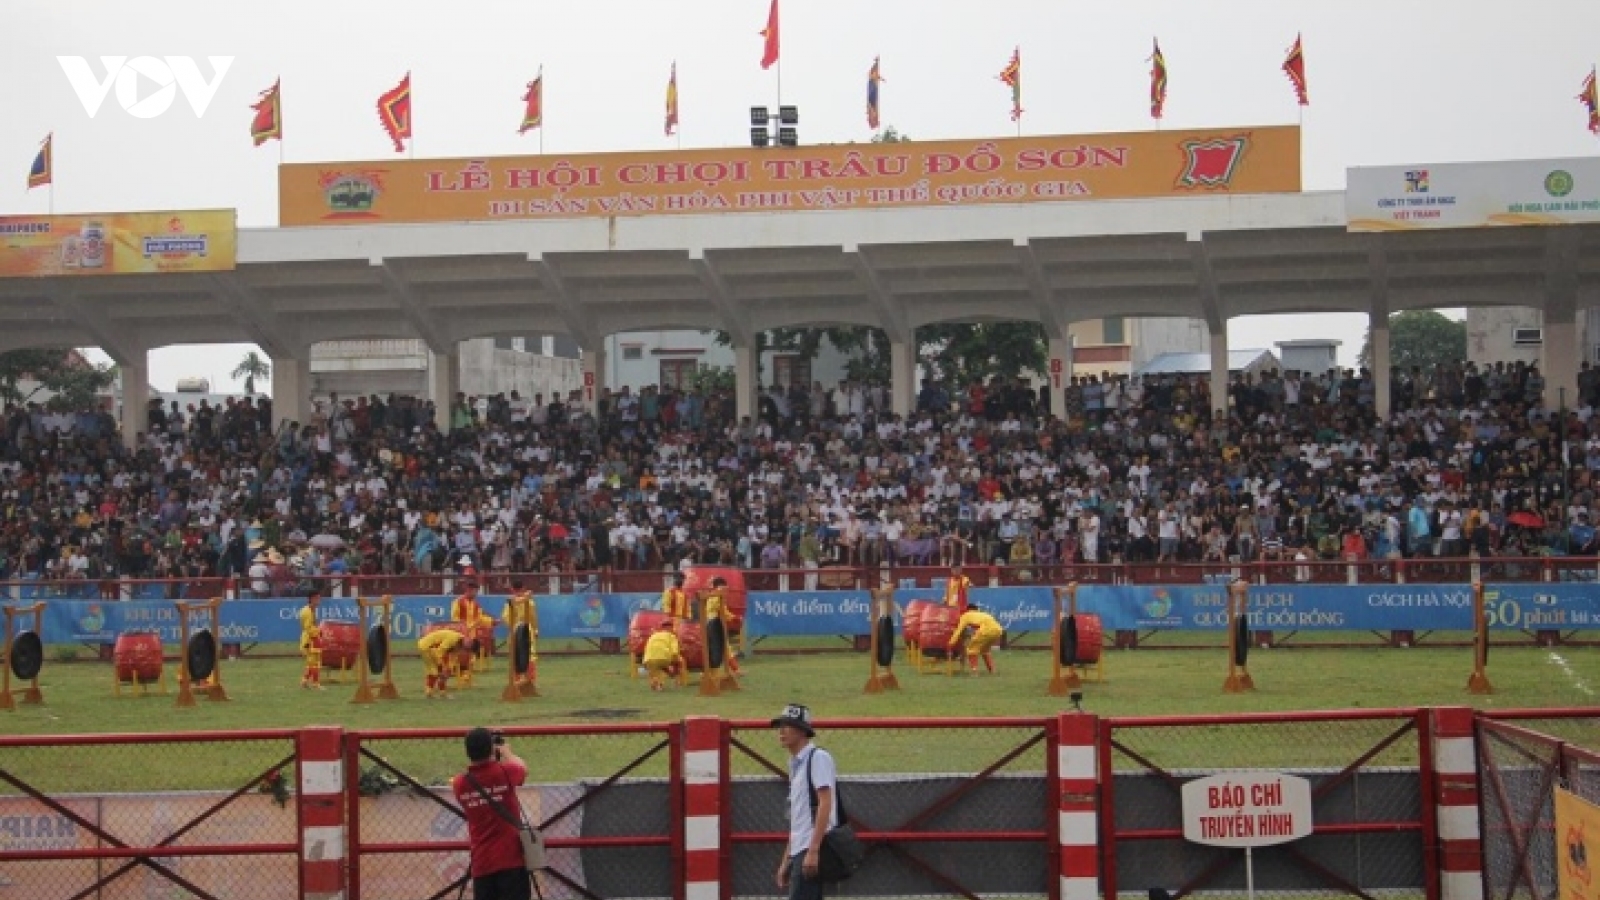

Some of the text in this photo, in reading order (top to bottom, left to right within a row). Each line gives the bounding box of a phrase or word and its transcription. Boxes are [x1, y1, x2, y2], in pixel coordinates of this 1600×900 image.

[426, 142, 1128, 193] LỄ HỘI CHỌI TRÂU ĐỒ SƠN
[489, 200, 521, 215] DI
[529, 193, 589, 215] SẢN
[597, 192, 655, 213] VĂN
[736, 191, 792, 208] PHI
[798, 187, 860, 208] VẬT
[936, 178, 1025, 205] QUỐC
[1032, 180, 1090, 198] GIA
[755, 600, 788, 617] Một
[1256, 593, 1294, 608] LỊCH
[1368, 589, 1470, 608] CÁCH HÀ NỘI
[1193, 608, 1232, 626] QUỐ
[1208, 778, 1282, 809] BÁO CHÍ
[1200, 809, 1293, 839] TRUYỀN HÌNH
